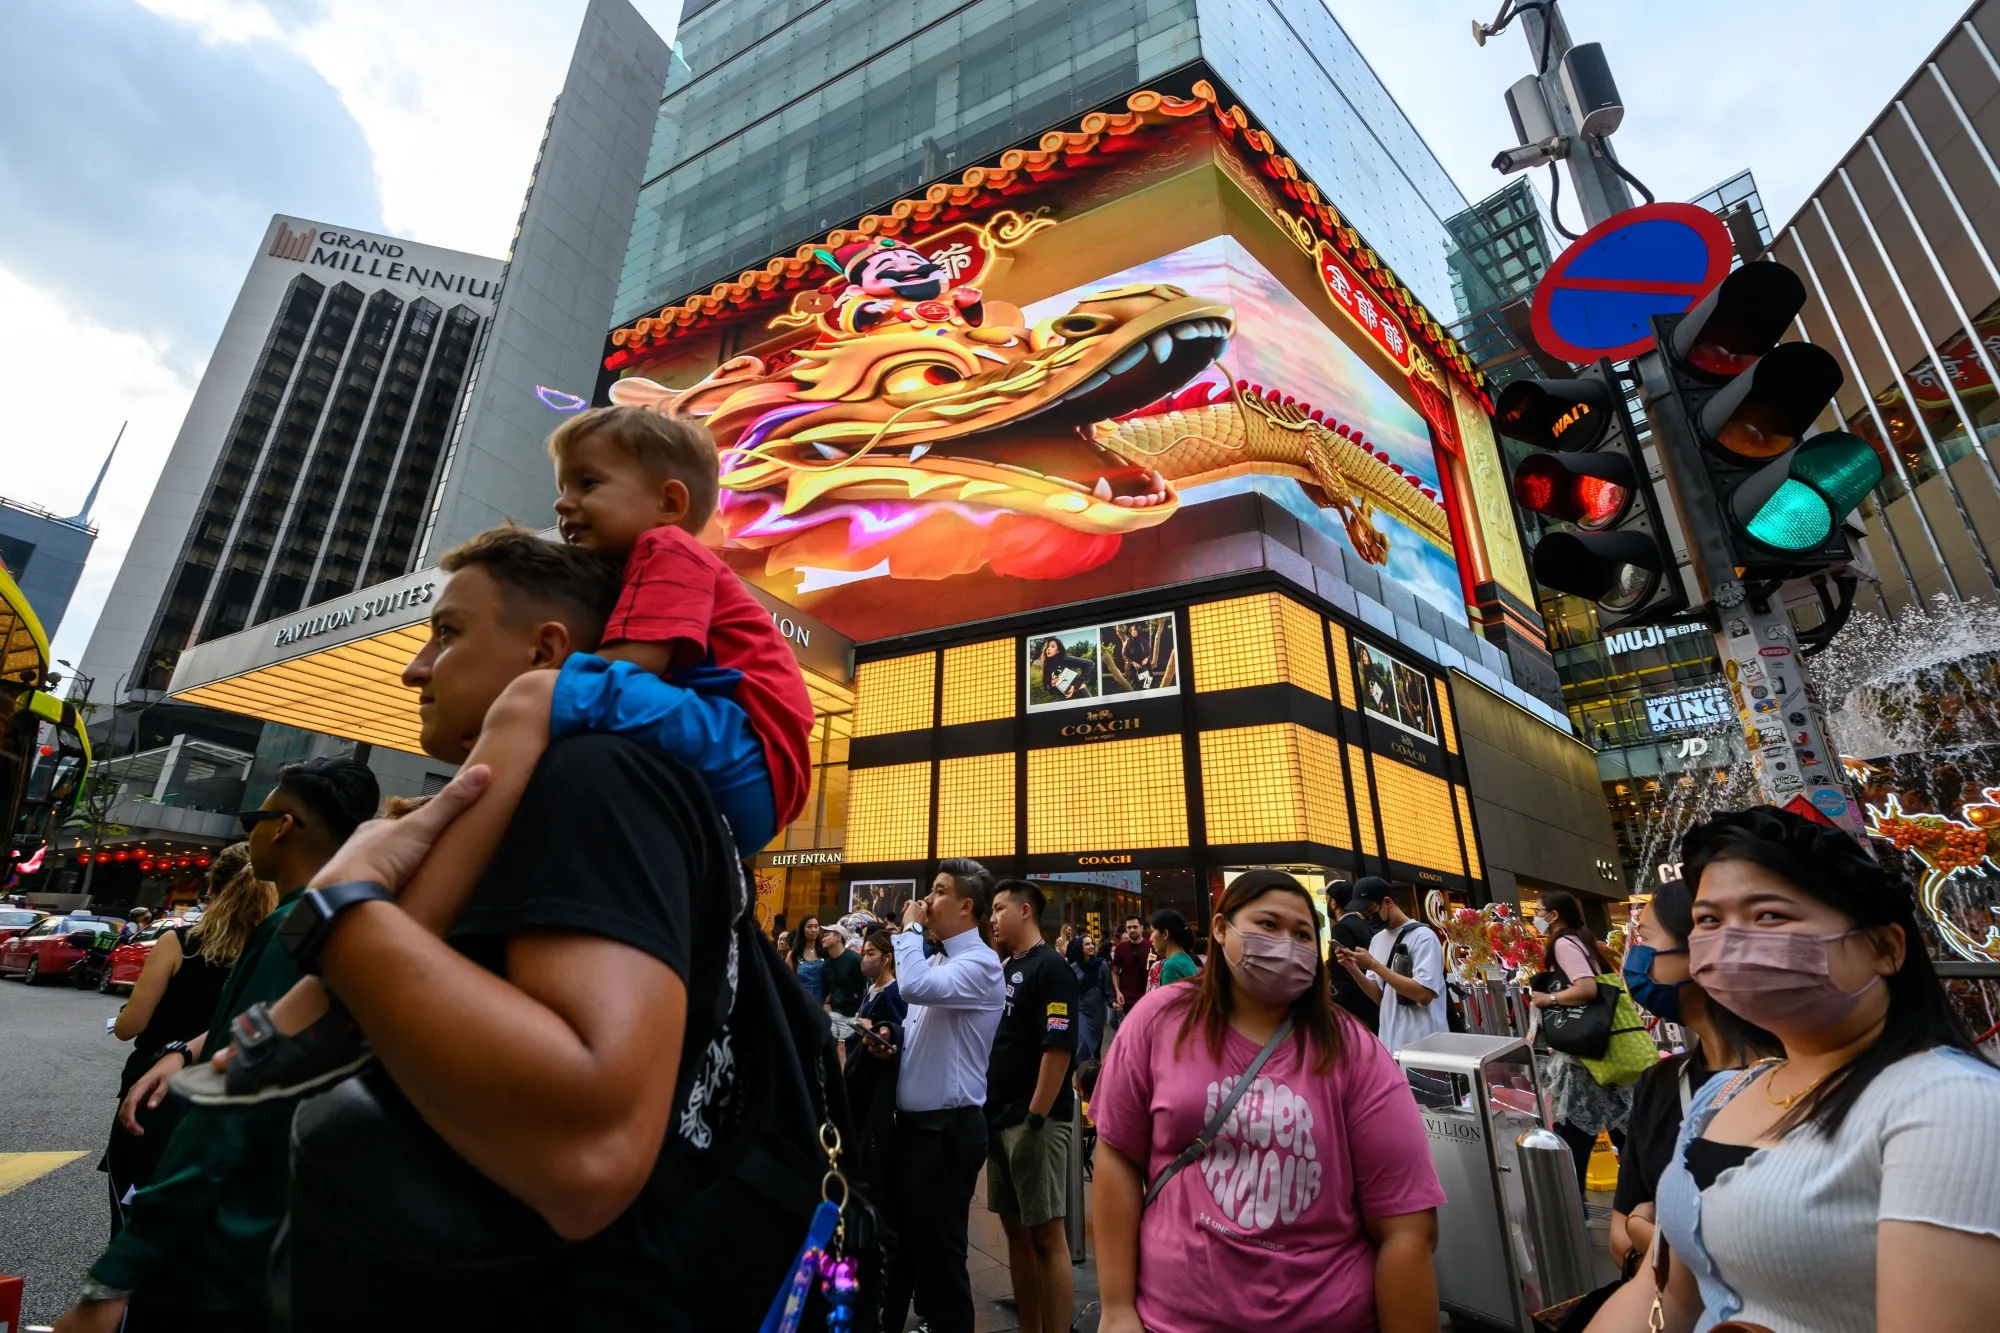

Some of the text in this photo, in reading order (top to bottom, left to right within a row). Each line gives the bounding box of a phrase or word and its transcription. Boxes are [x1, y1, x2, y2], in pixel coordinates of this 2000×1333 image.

[319, 231, 404, 258] GRAND
[1551, 403, 1590, 438] WAIT
[273, 581, 435, 647] PAVILION SUITES
[1604, 625, 1666, 656] MUJI
[1648, 696, 1729, 724] KING
[1061, 718, 1140, 736] COACH
[1653, 723, 1669, 732] OF
[1391, 742, 1427, 764] COACH
[1677, 738, 1708, 759] JD
[772, 854, 798, 866] ELITE
[1078, 855, 1132, 865] COACH
[1419, 871, 1443, 882] COACH
[1423, 1119, 1481, 1140] VILION
[1211, 1220, 1243, 1241] UNDER
